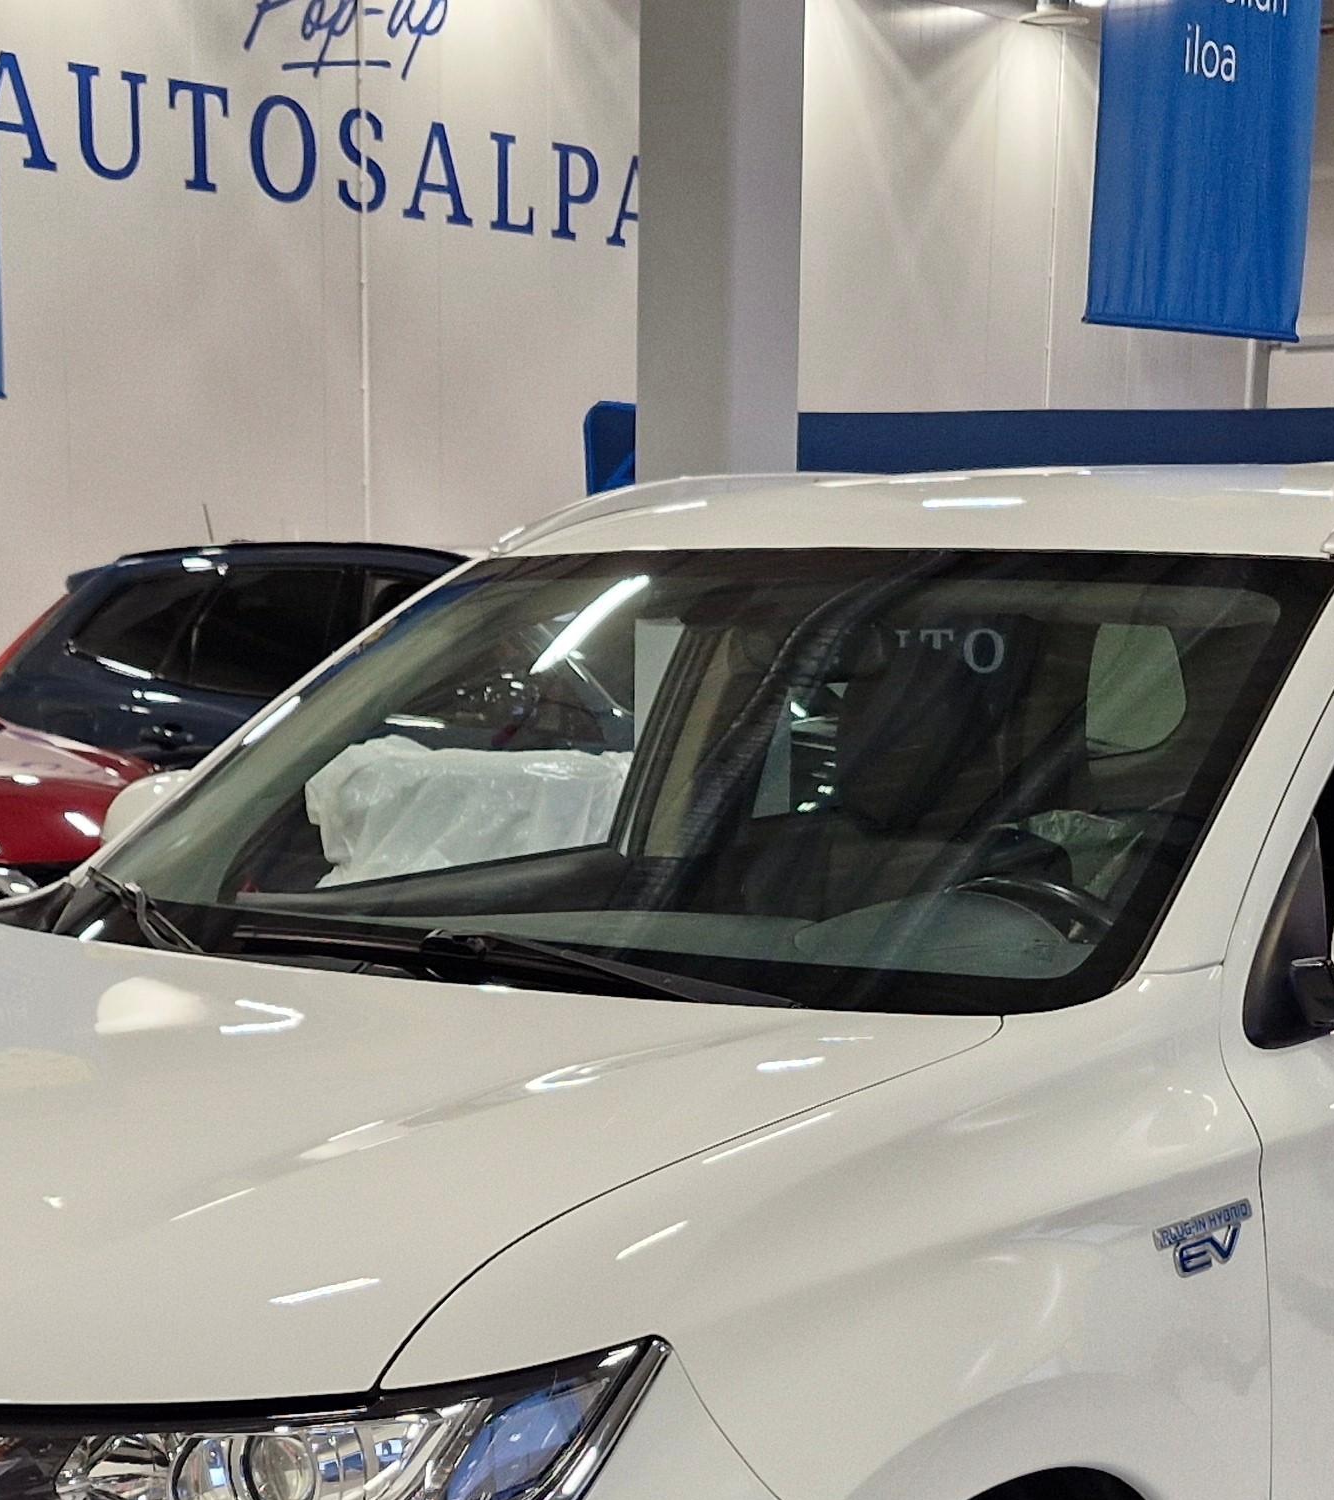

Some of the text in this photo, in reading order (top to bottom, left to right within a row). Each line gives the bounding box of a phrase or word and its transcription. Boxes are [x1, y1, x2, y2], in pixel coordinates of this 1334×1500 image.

[1184, 22, 1237, 83] iloa
[1208, 1202, 1249, 1228] HYBRID
[1175, 1222, 1241, 1276] EV
